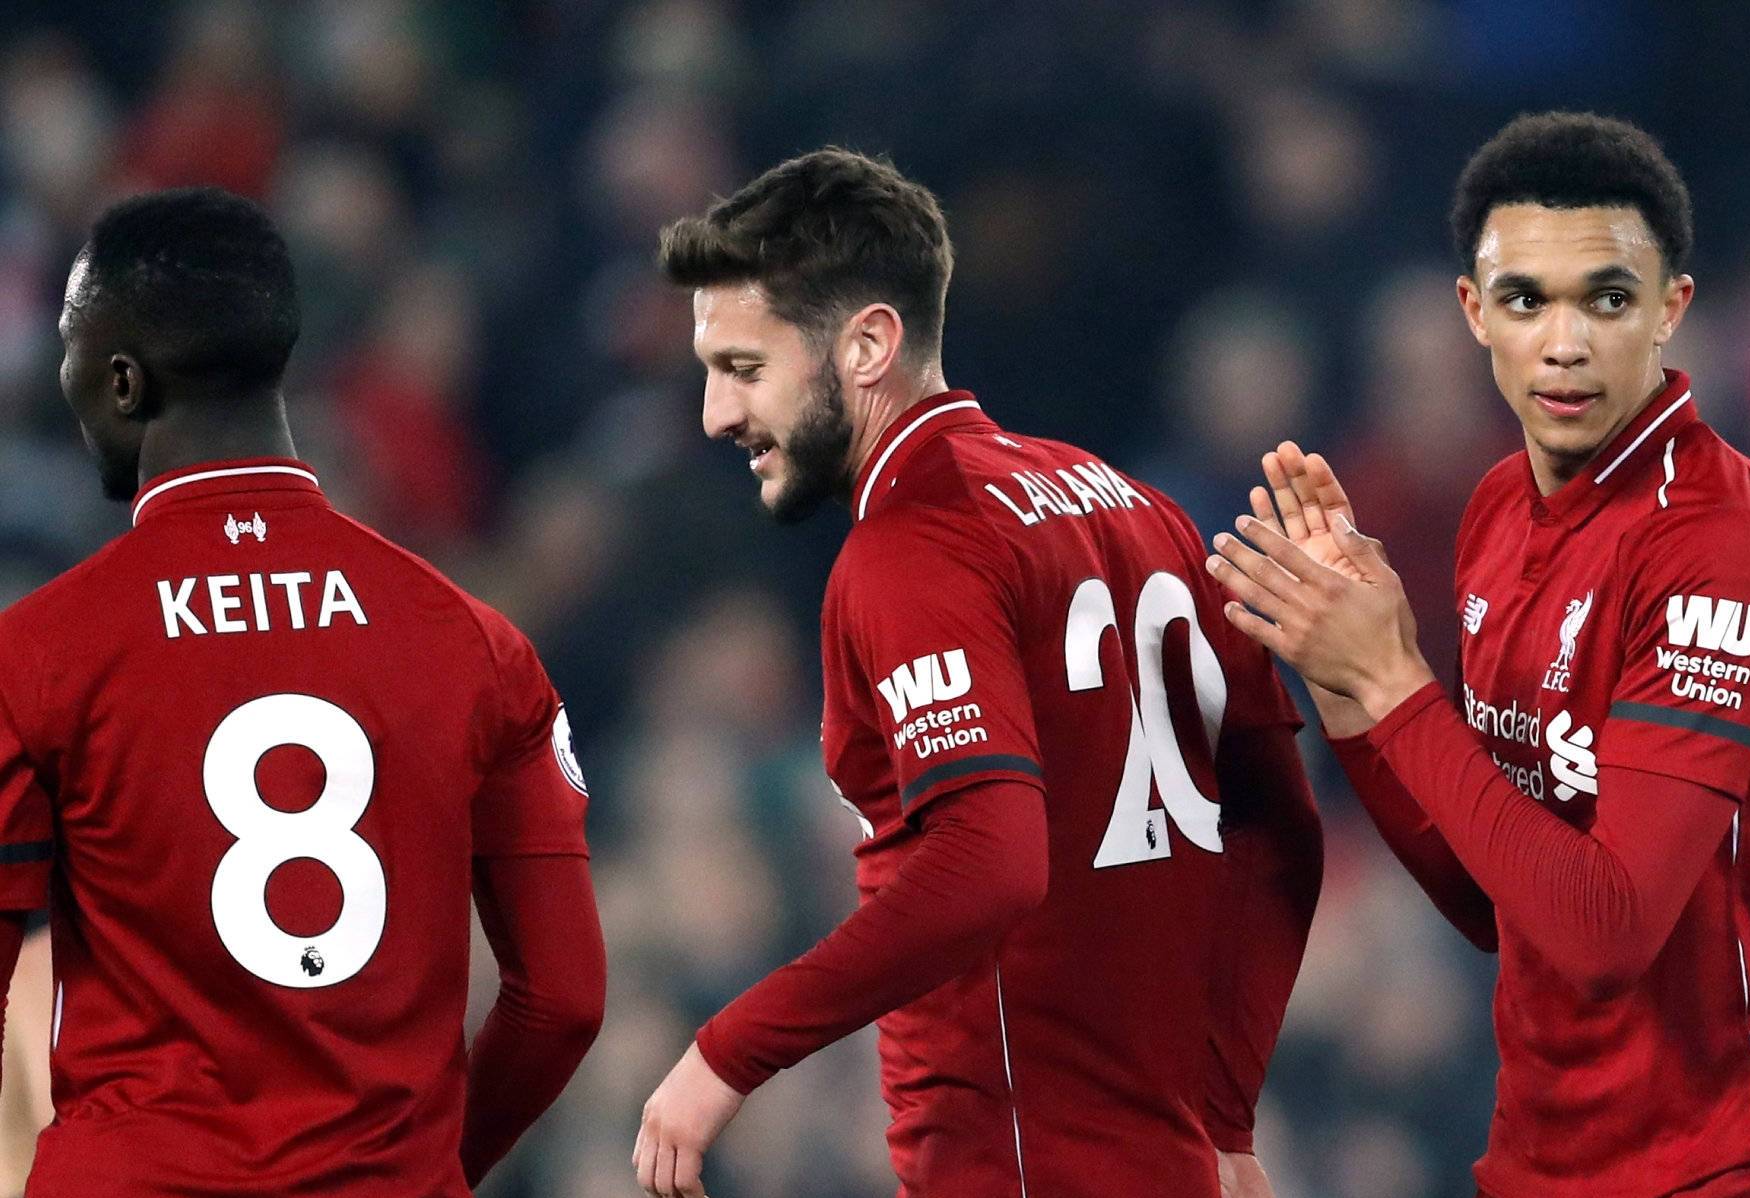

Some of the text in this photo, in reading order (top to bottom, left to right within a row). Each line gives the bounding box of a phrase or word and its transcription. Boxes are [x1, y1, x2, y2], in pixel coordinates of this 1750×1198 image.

[237, 521, 253, 534] 96
[157, 570, 368, 638] KEITA
[876, 648, 972, 724] WU
[1656, 646, 1750, 685] Western
[1671, 672, 1742, 710] Union
[893, 702, 981, 750] Western
[914, 725, 988, 759] Union
[1065, 571, 1227, 868] 20
[1463, 682, 1541, 748] Standard
[202, 693, 388, 989] 8
